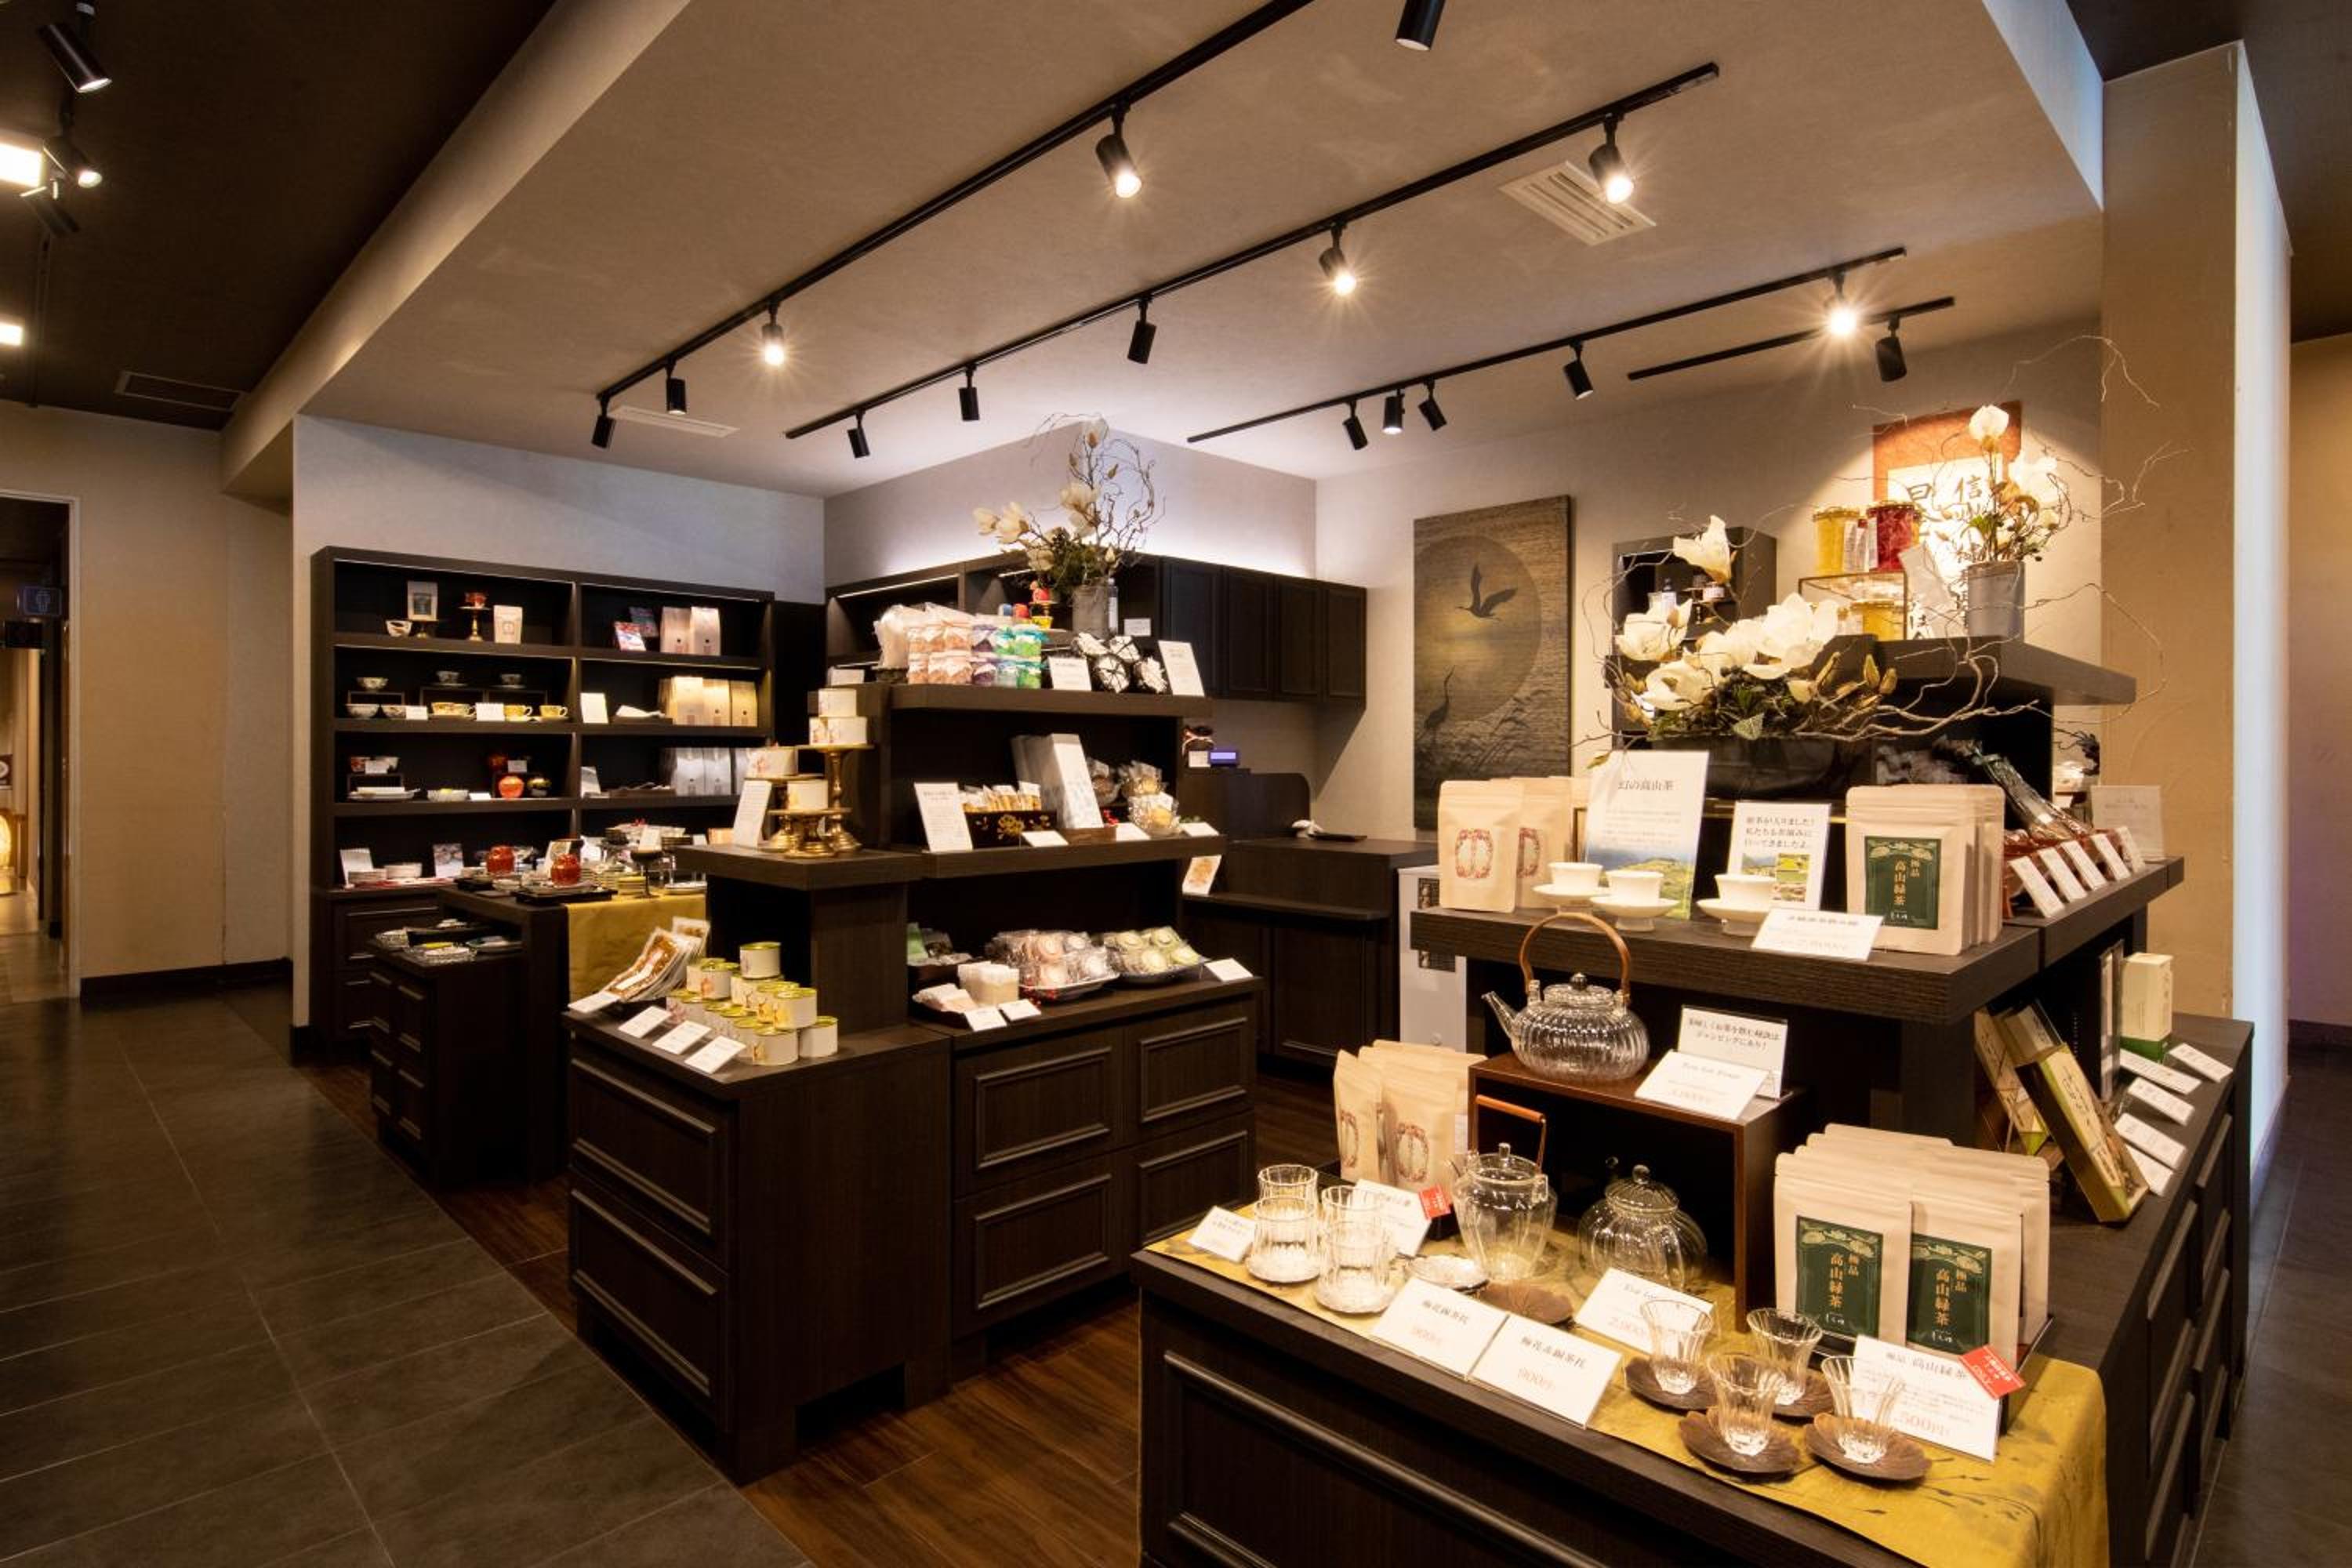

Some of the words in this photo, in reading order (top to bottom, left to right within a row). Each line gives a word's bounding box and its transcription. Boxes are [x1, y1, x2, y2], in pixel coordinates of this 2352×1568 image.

[1954, 474, 1983, 503] 信
[1617, 780, 1675, 791] 幻の高山茶
[1830, 1254, 1844, 1308] 高山緑茶
[1935, 1269, 1951, 1326] 高山緑茶
